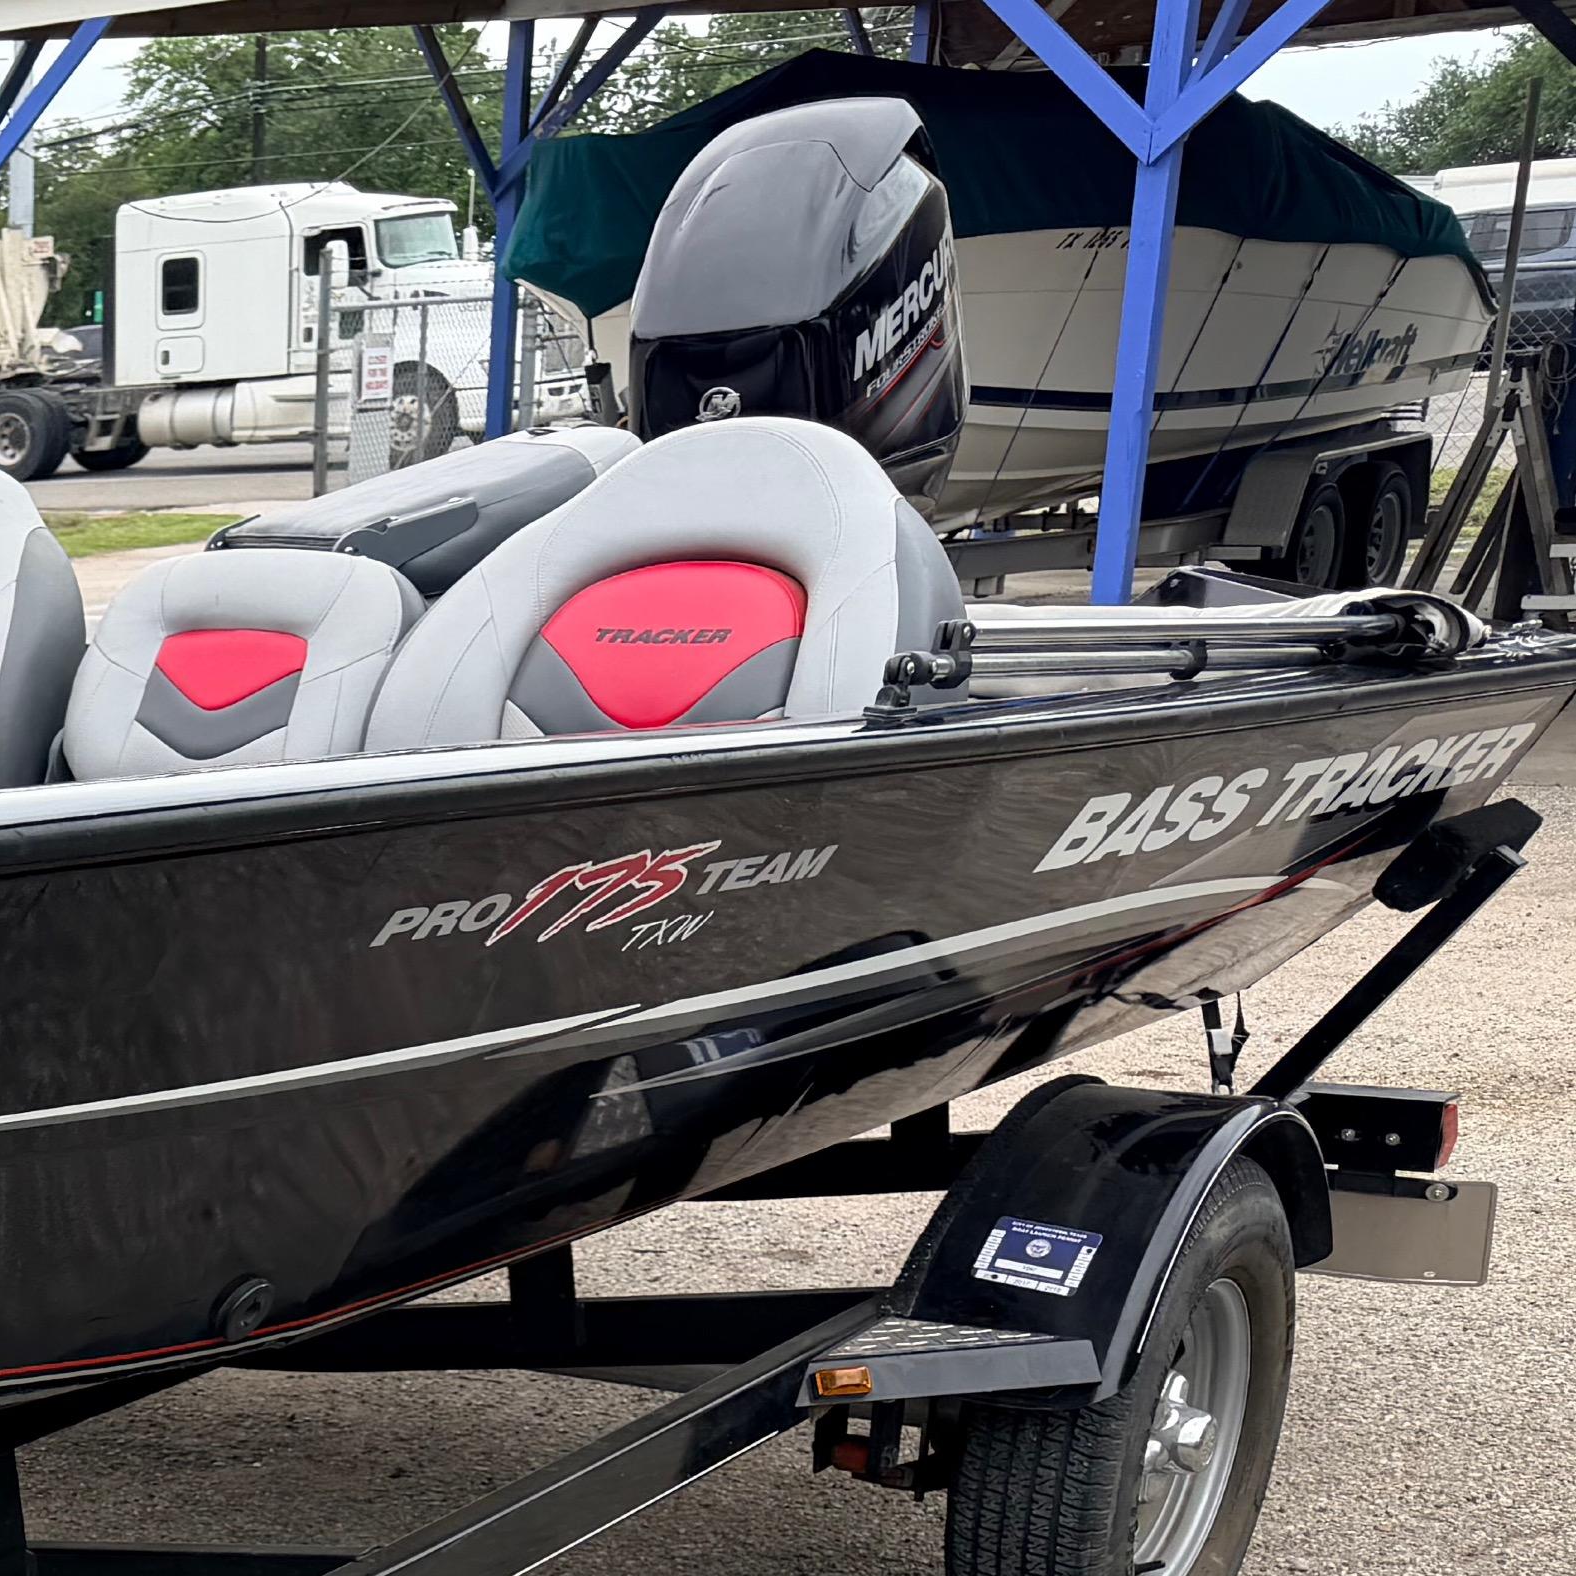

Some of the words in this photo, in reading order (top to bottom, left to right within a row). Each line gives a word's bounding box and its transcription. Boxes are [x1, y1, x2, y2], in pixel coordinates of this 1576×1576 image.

[595, 628, 733, 644] TRACKER
[1033, 767, 1269, 873] BASS
[1256, 722, 1537, 828] TRACKER
[369, 893, 512, 947] PRO
[485, 840, 722, 946] 175
[696, 844, 838, 896] TEAM
[622, 910, 714, 952] TXW
